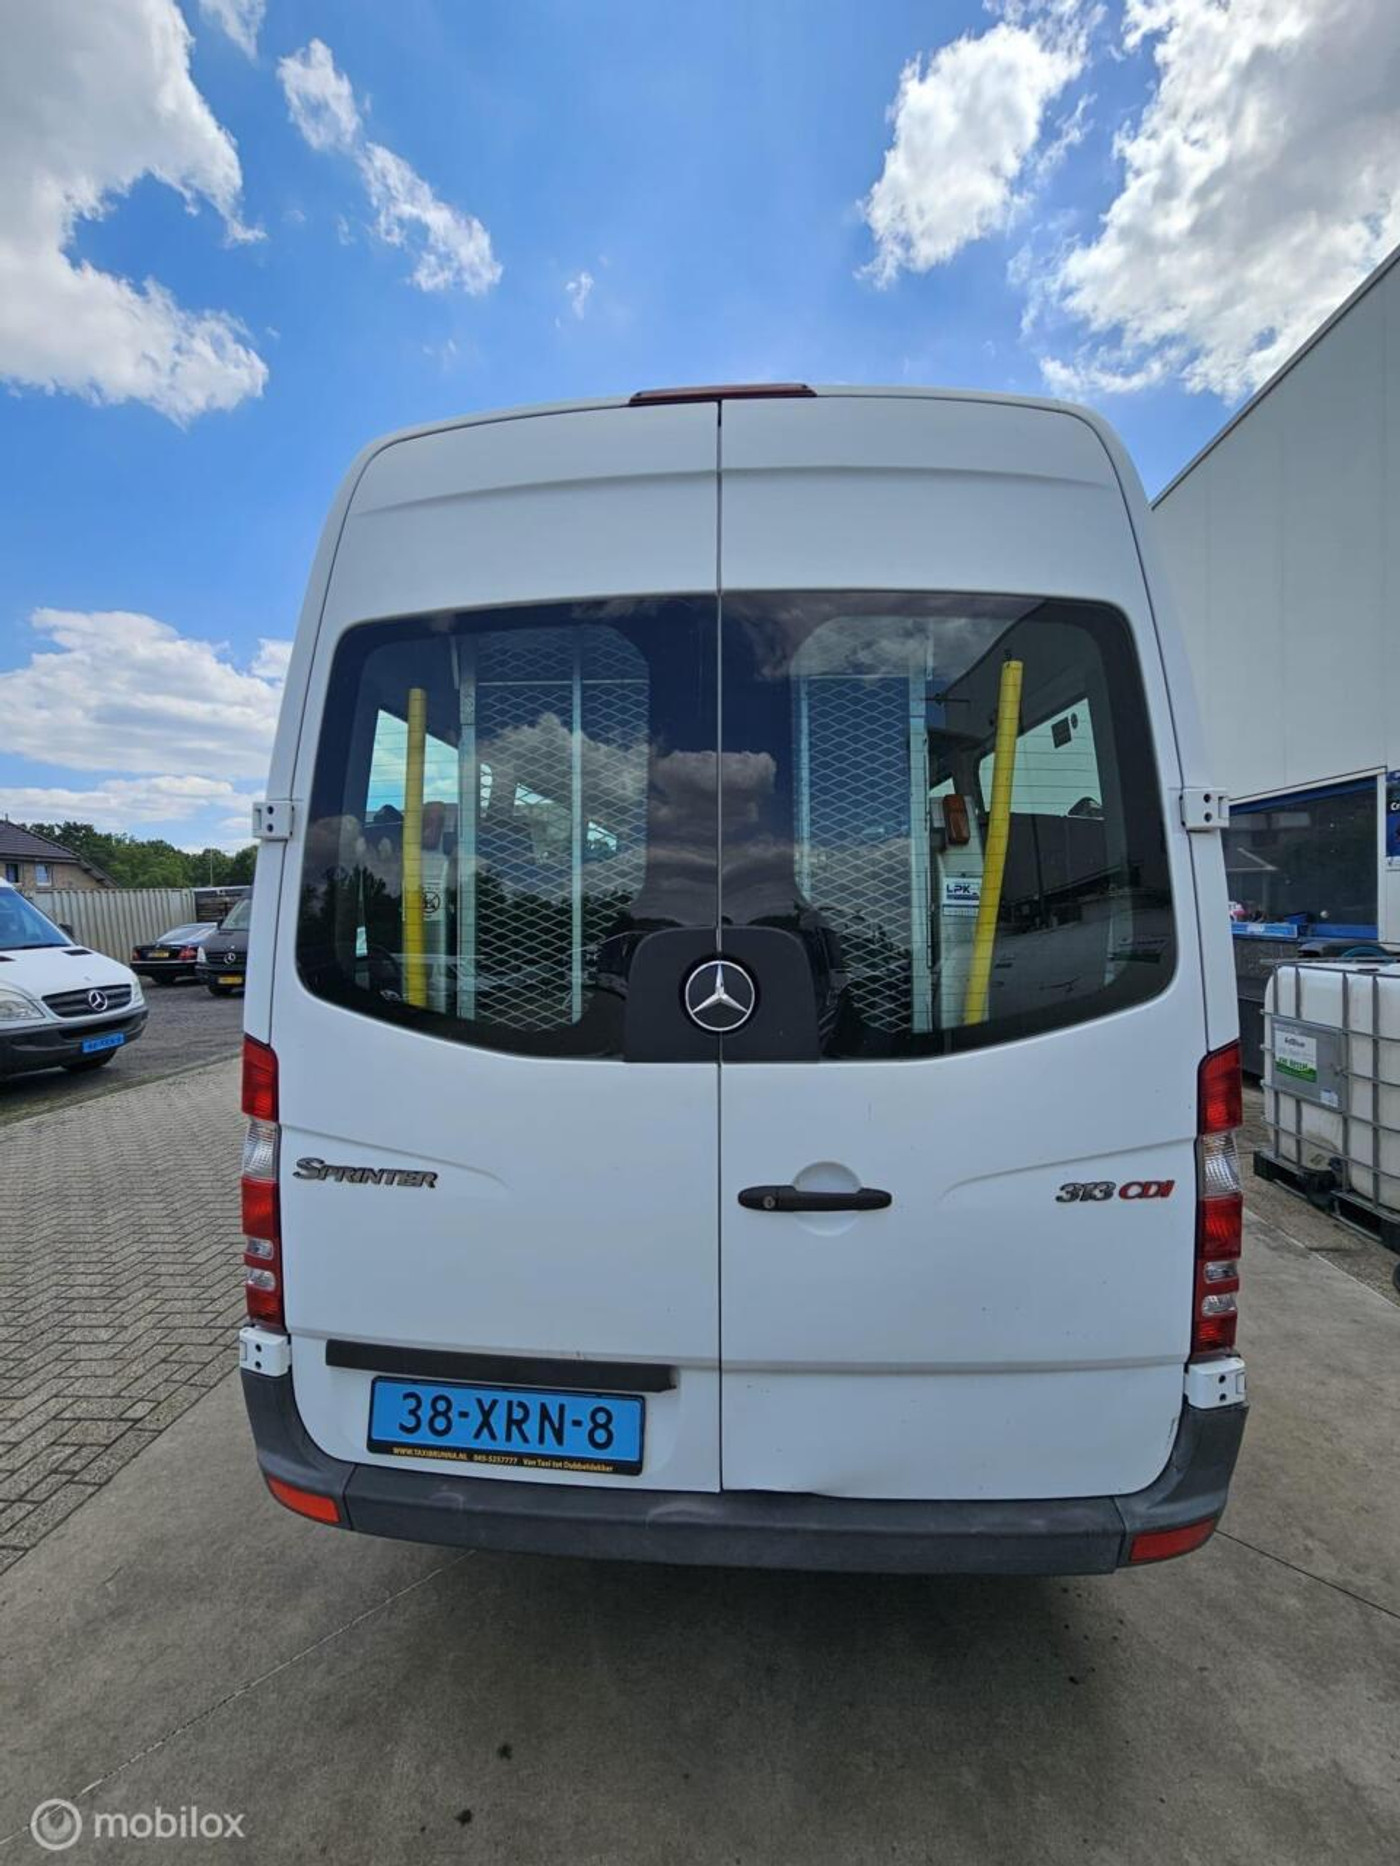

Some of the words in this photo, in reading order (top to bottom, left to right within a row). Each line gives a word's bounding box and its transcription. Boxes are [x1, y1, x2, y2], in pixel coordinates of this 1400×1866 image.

[292, 1157, 438, 1188] SPRINTER
[1118, 1179, 1175, 1200] CDI
[398, 1391, 614, 1451] 38-XRN-8
